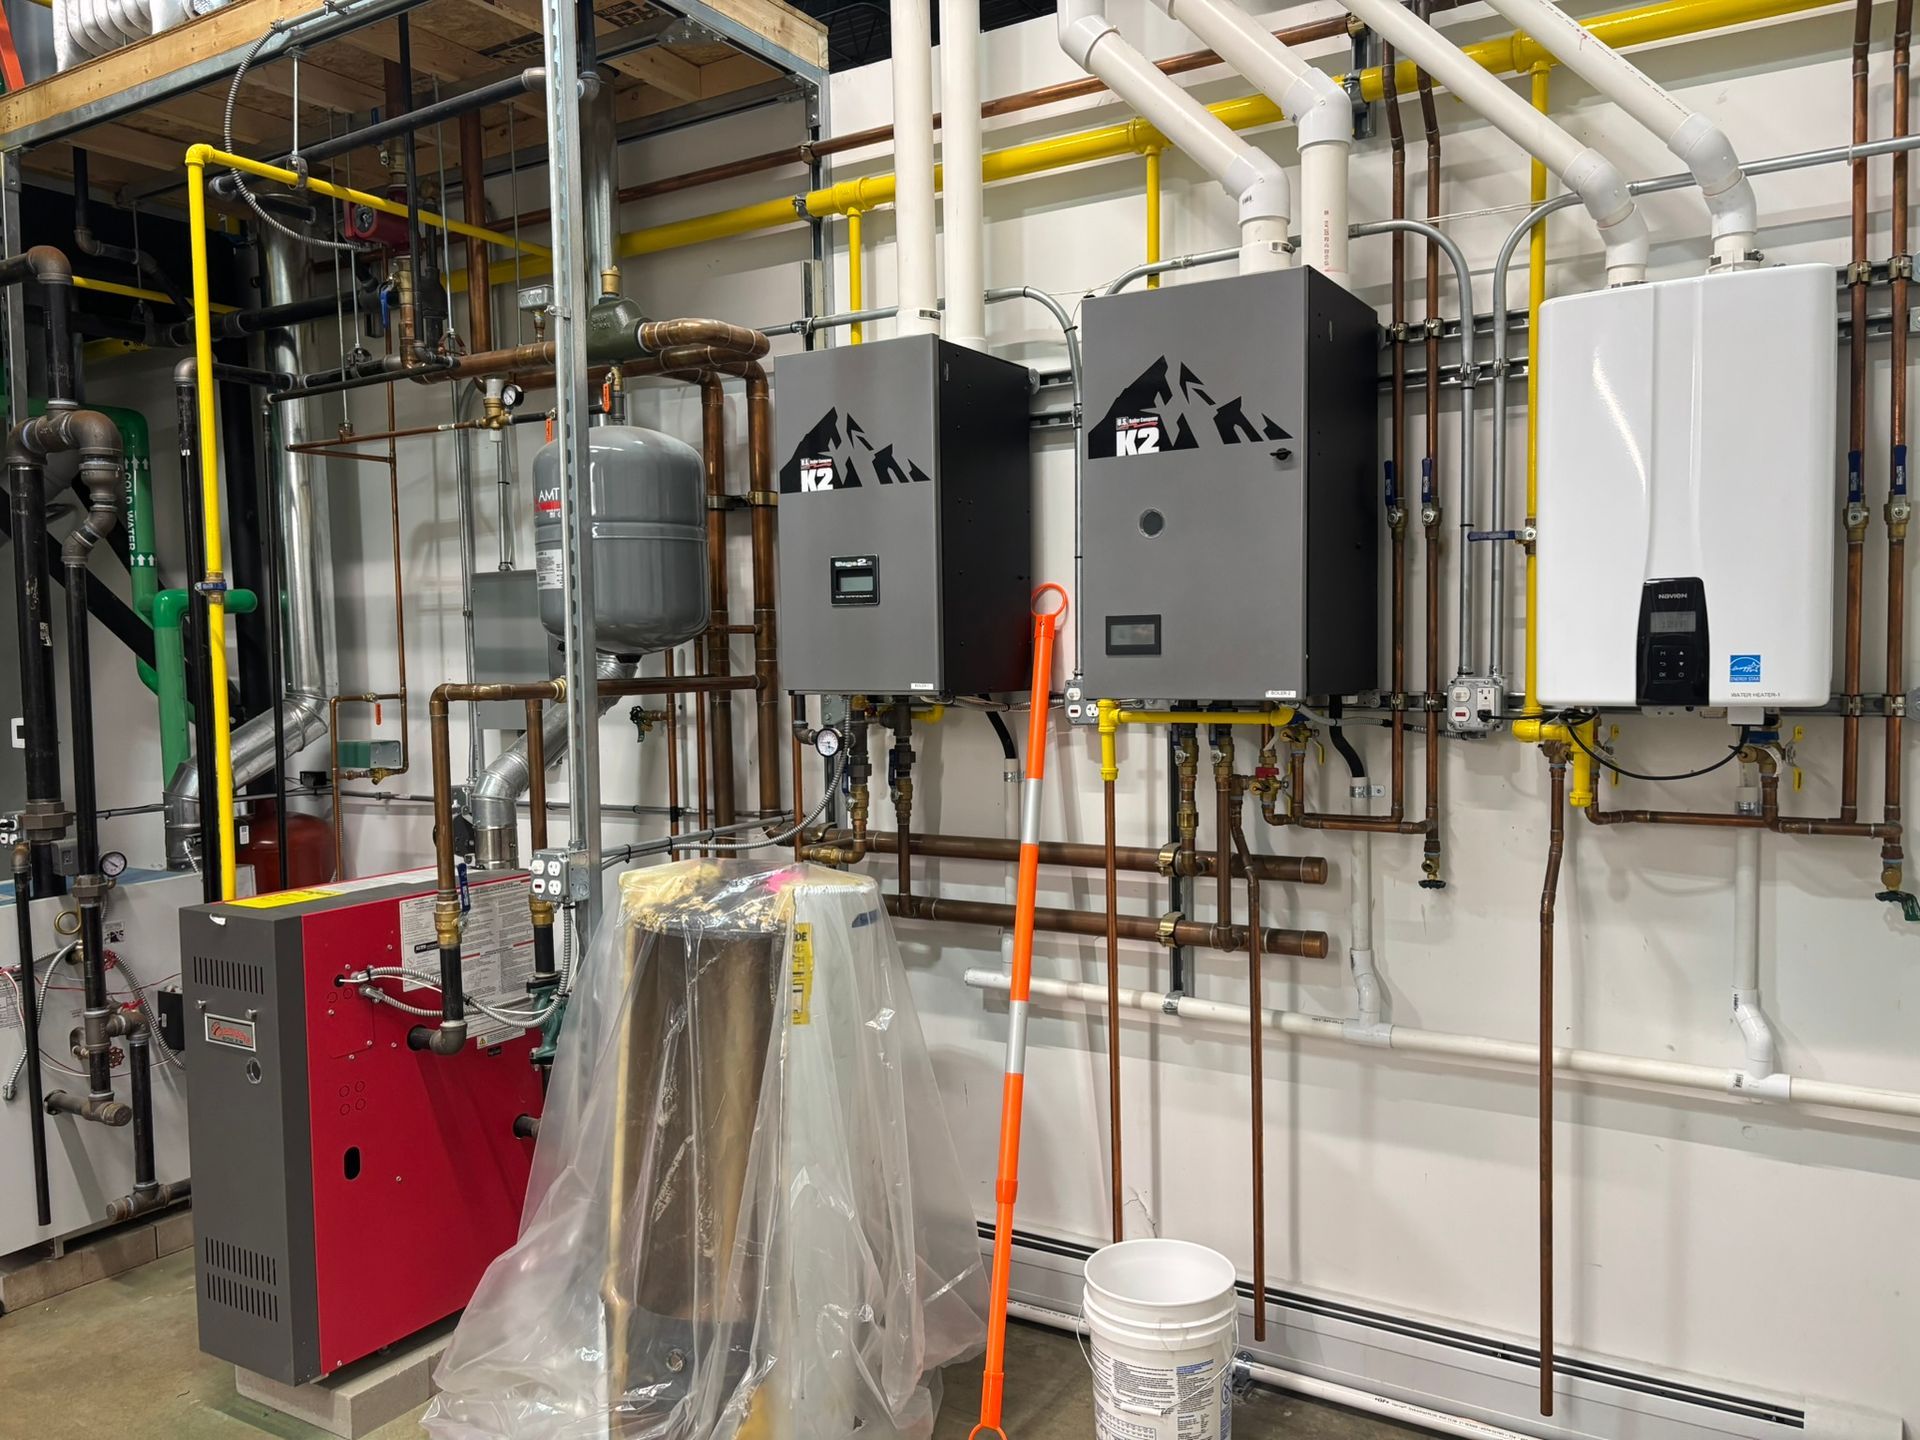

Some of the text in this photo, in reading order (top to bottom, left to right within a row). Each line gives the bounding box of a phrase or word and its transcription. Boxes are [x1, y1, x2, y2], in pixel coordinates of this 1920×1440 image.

[1116, 427, 1160, 457] K2
[124, 472, 133, 505] COLD
[800, 467, 834, 493] K2
[126, 510, 136, 551] WATER
